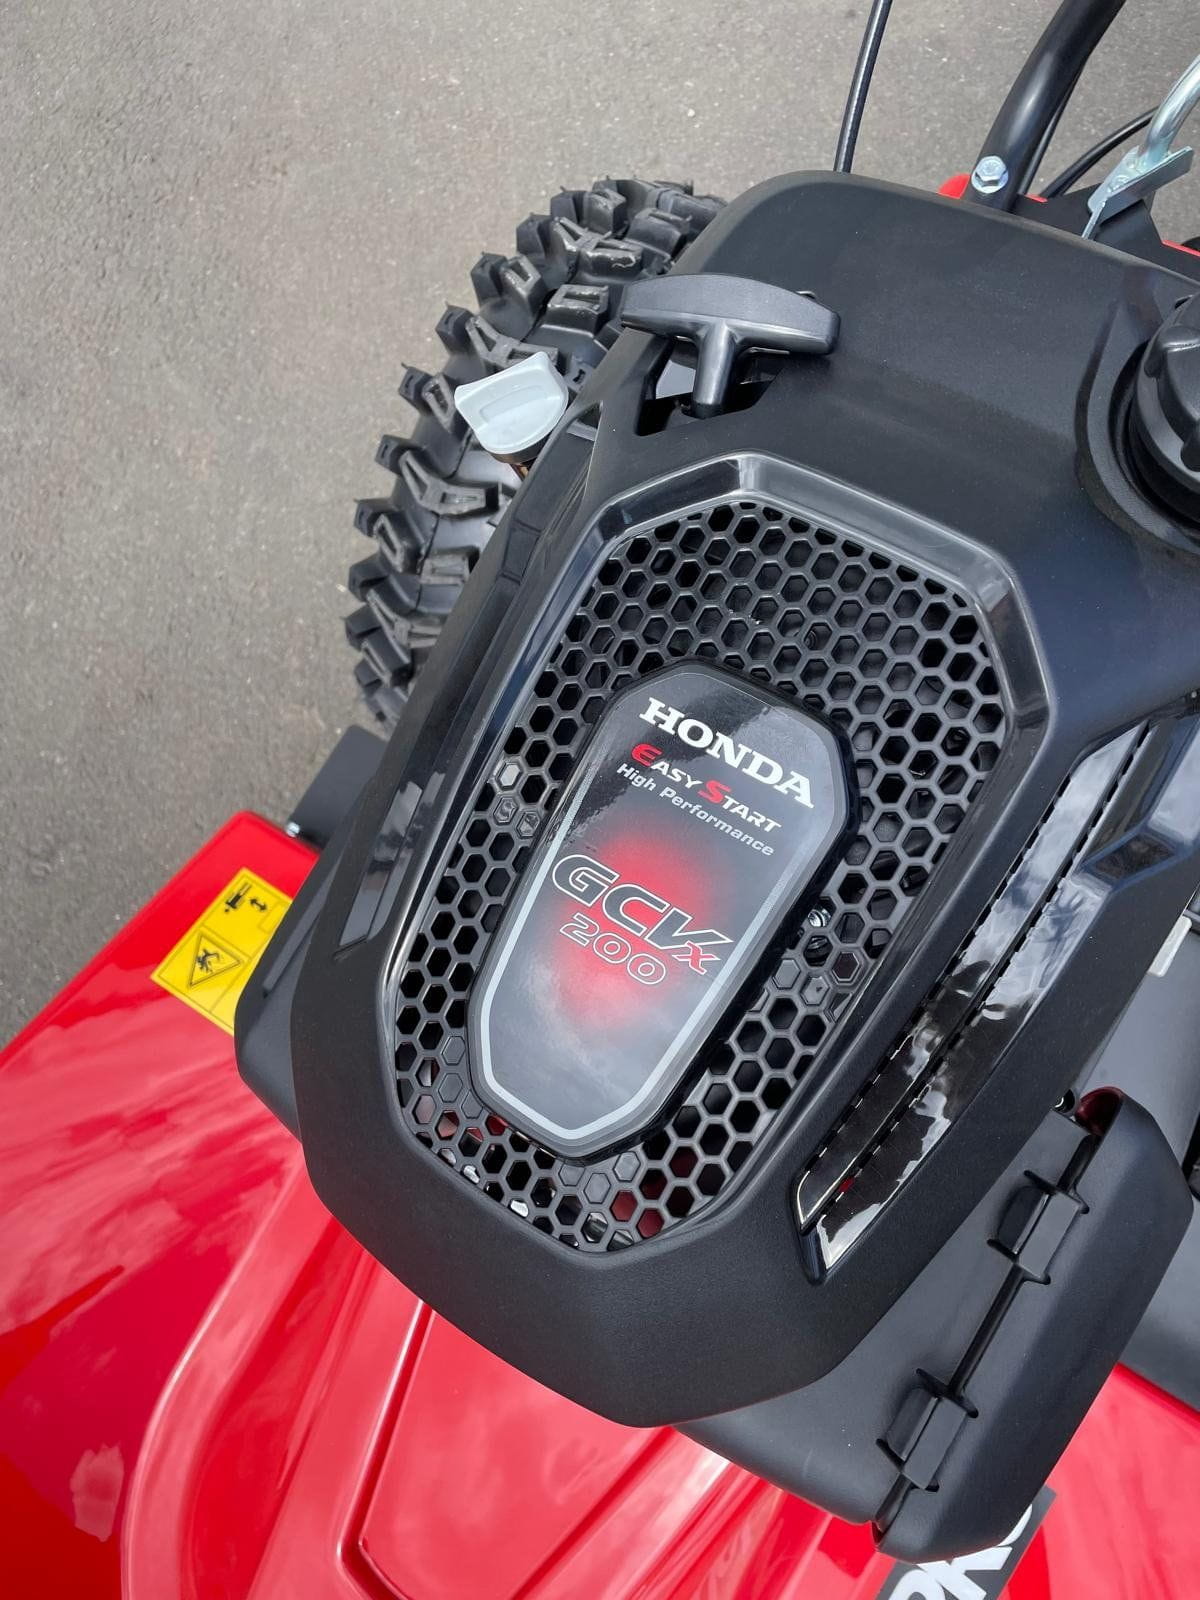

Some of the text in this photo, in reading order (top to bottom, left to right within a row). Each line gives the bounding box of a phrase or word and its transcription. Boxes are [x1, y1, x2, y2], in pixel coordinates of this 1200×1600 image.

[639, 697, 814, 808] HONDA
[616, 762, 775, 856] High Performance
[697, 780, 782, 833] START
[559, 912, 666, 985] 200
